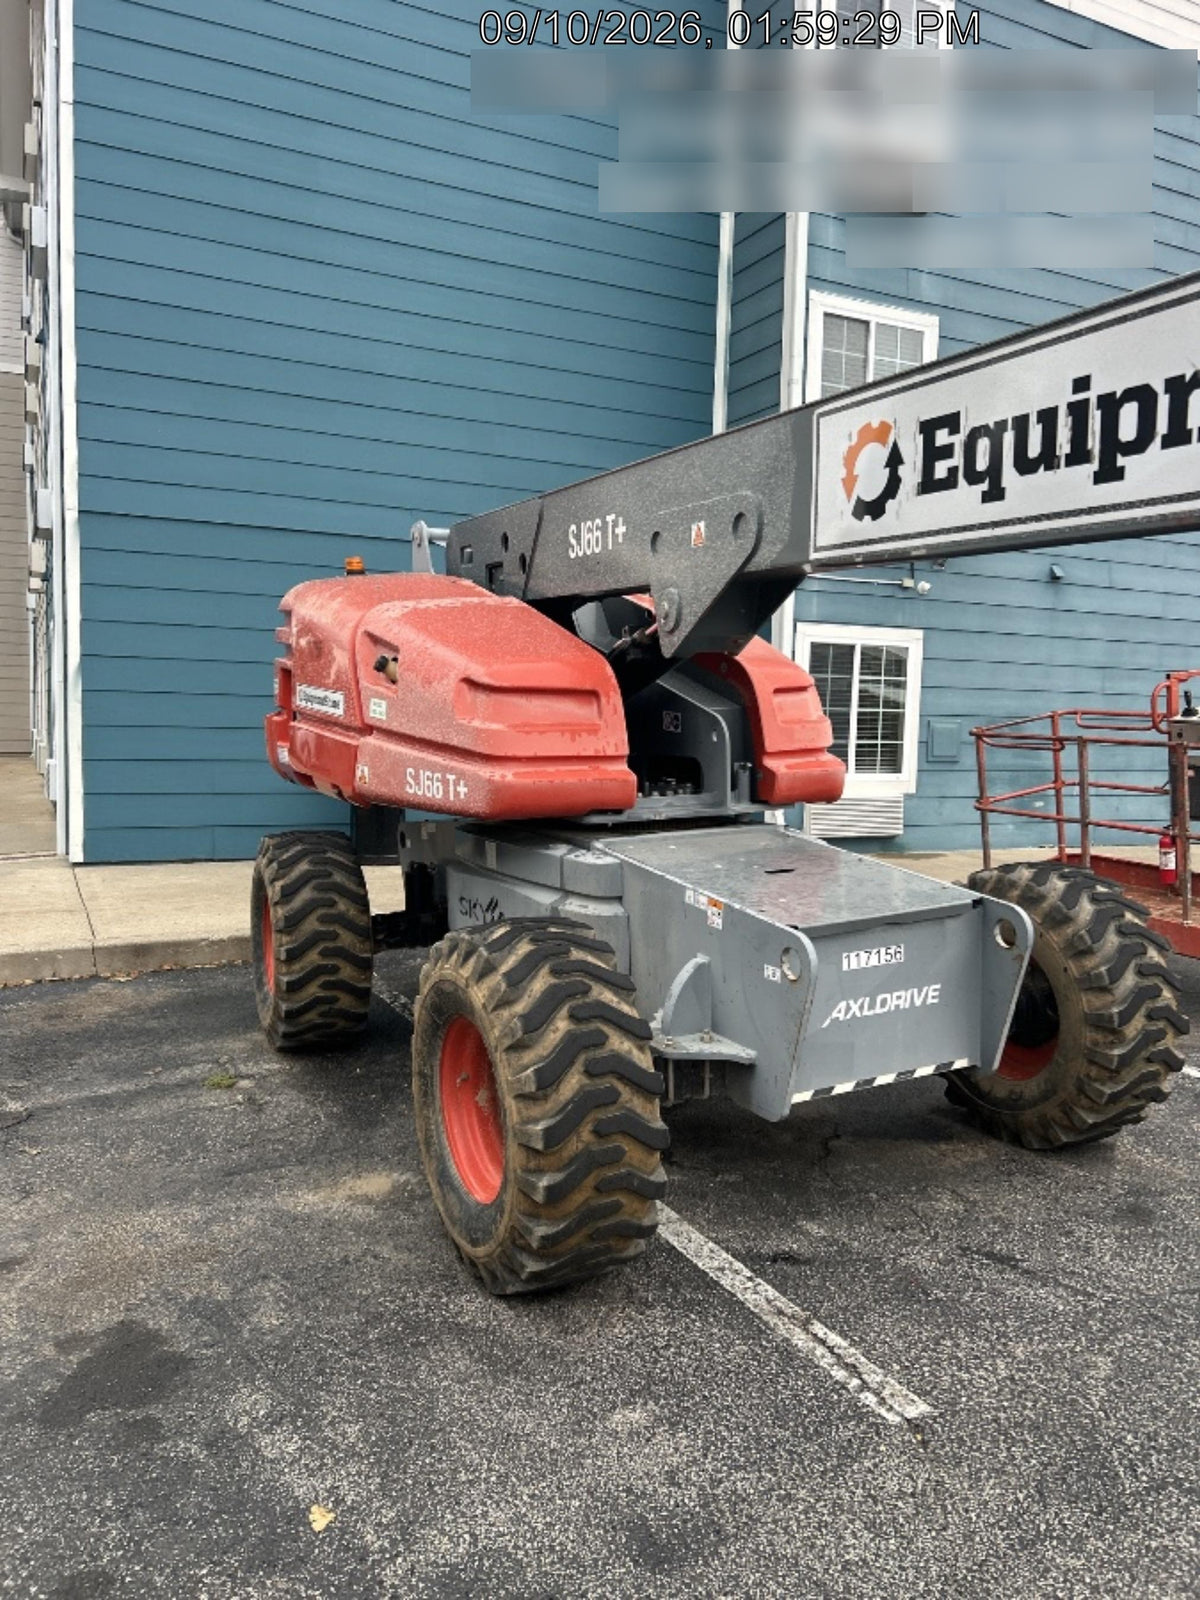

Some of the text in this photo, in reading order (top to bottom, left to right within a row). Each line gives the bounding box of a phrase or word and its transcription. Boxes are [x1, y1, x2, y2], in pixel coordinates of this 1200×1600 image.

[568, 513, 627, 559] SJ66 T+
[405, 767, 469, 801] SJ66 T+
[843, 944, 904, 970] 117156
[821, 983, 942, 1028] AXLDRIVE
